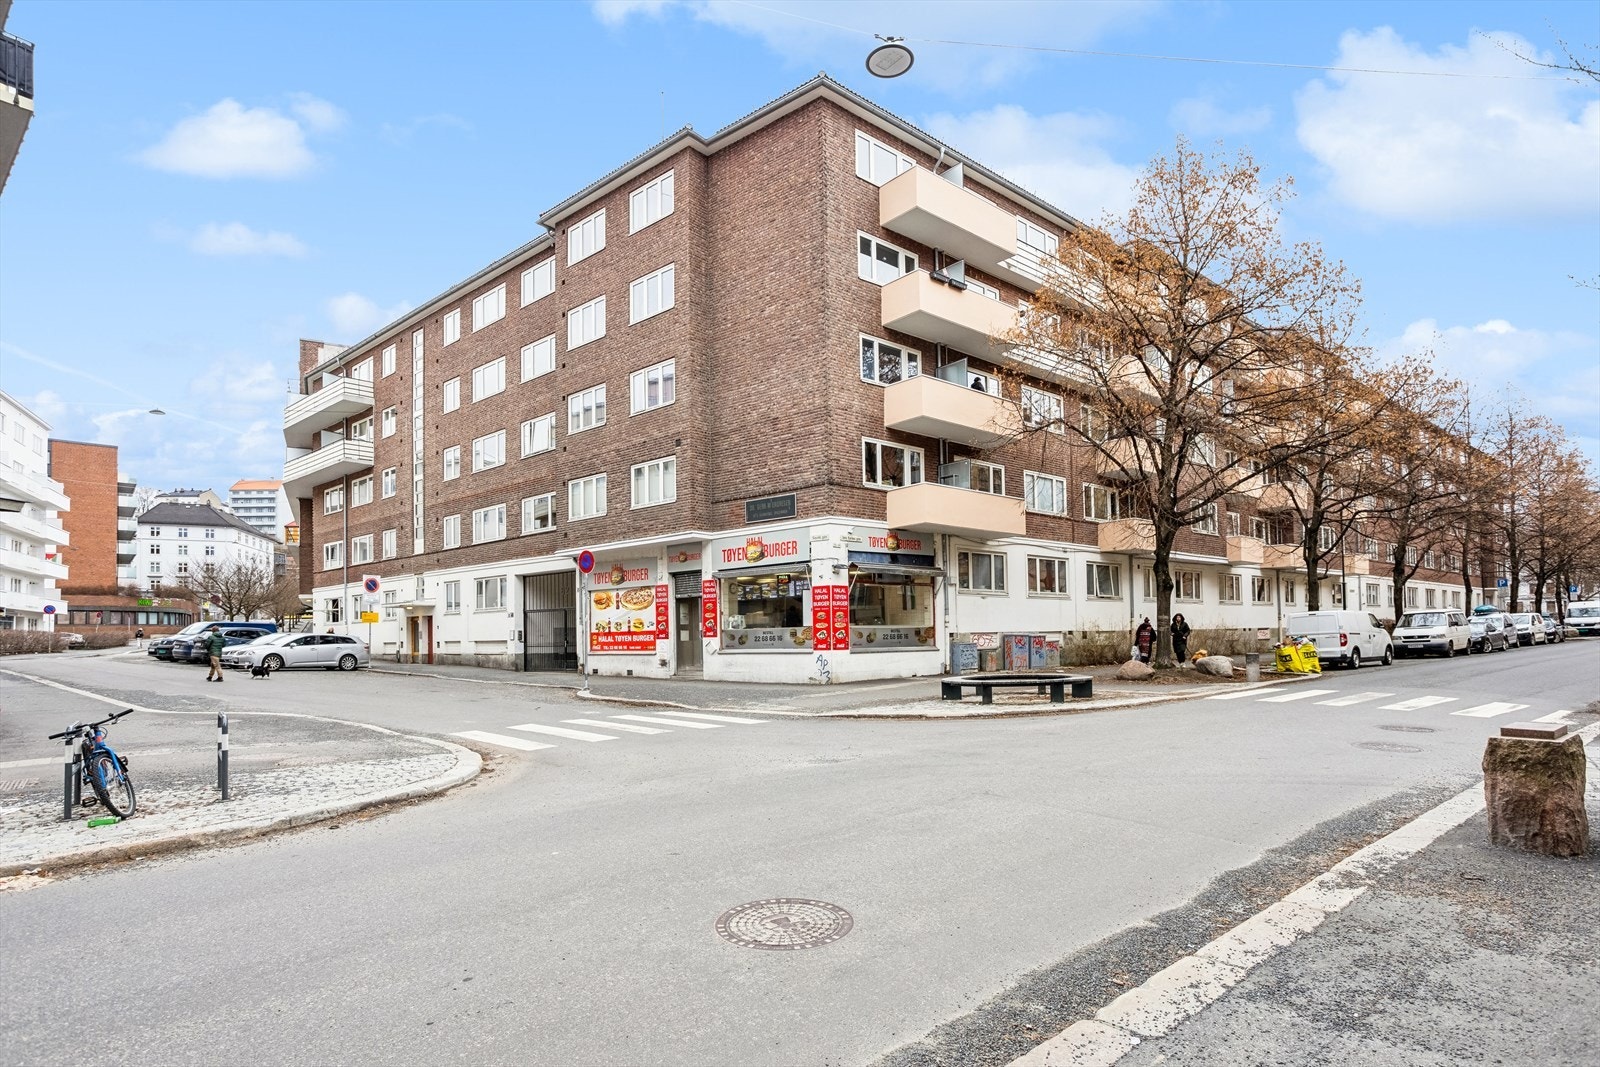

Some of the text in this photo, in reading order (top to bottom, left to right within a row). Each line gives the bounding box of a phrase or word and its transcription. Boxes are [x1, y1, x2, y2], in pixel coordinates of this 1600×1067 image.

[721, 540, 798, 563] TØYEN BURGER
[868, 536, 888, 549] TØYEN
[898, 538, 922, 551] BURGER
[593, 567, 649, 585] TØYEN BURGER
[633, 634, 655, 642] BURGER
